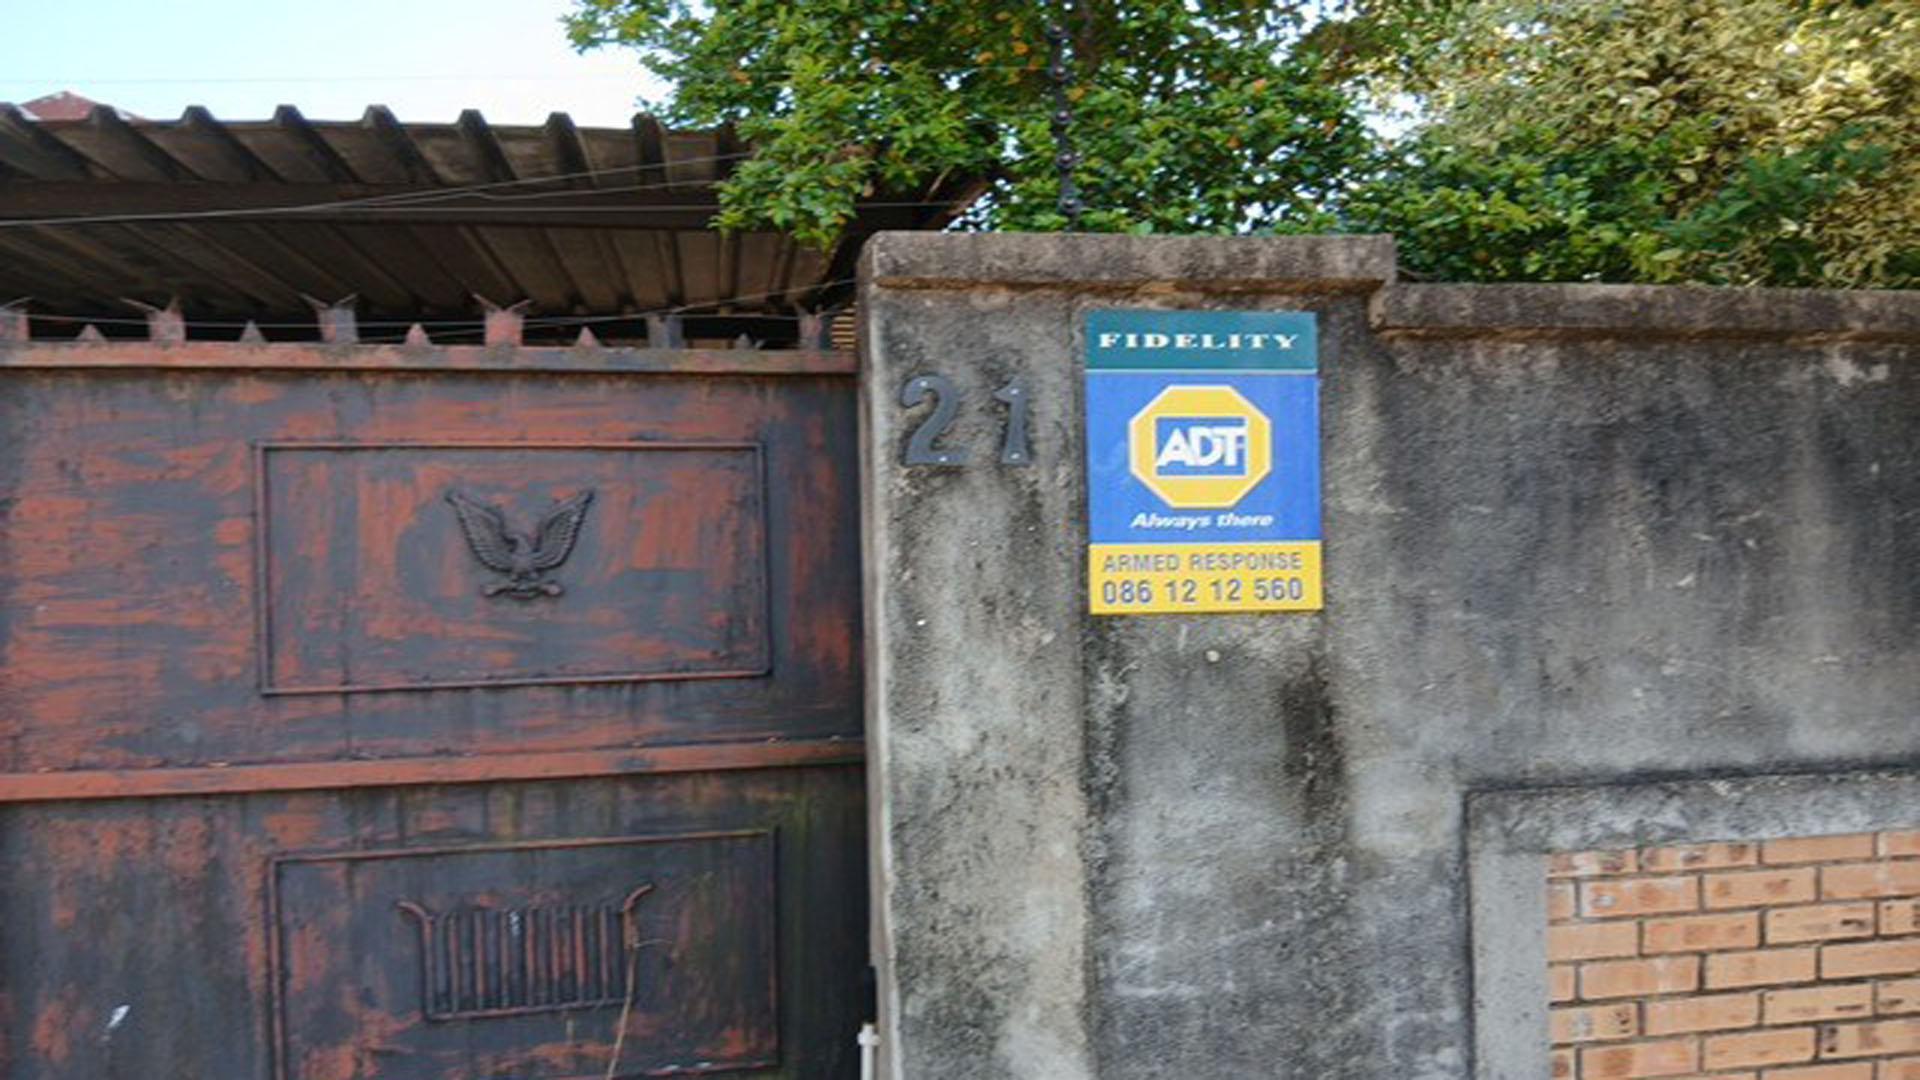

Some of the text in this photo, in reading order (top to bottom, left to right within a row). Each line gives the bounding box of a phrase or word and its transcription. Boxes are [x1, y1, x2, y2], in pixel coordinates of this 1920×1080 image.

[1099, 333, 1299, 349] FIDELITY
[901, 373, 1032, 465] 21
[1156, 424, 1247, 468] ADT
[1131, 511, 1274, 529] Always there
[1103, 551, 1303, 573] ARMED RESPONSE
[1102, 577, 1304, 604] 086 12 12 560
